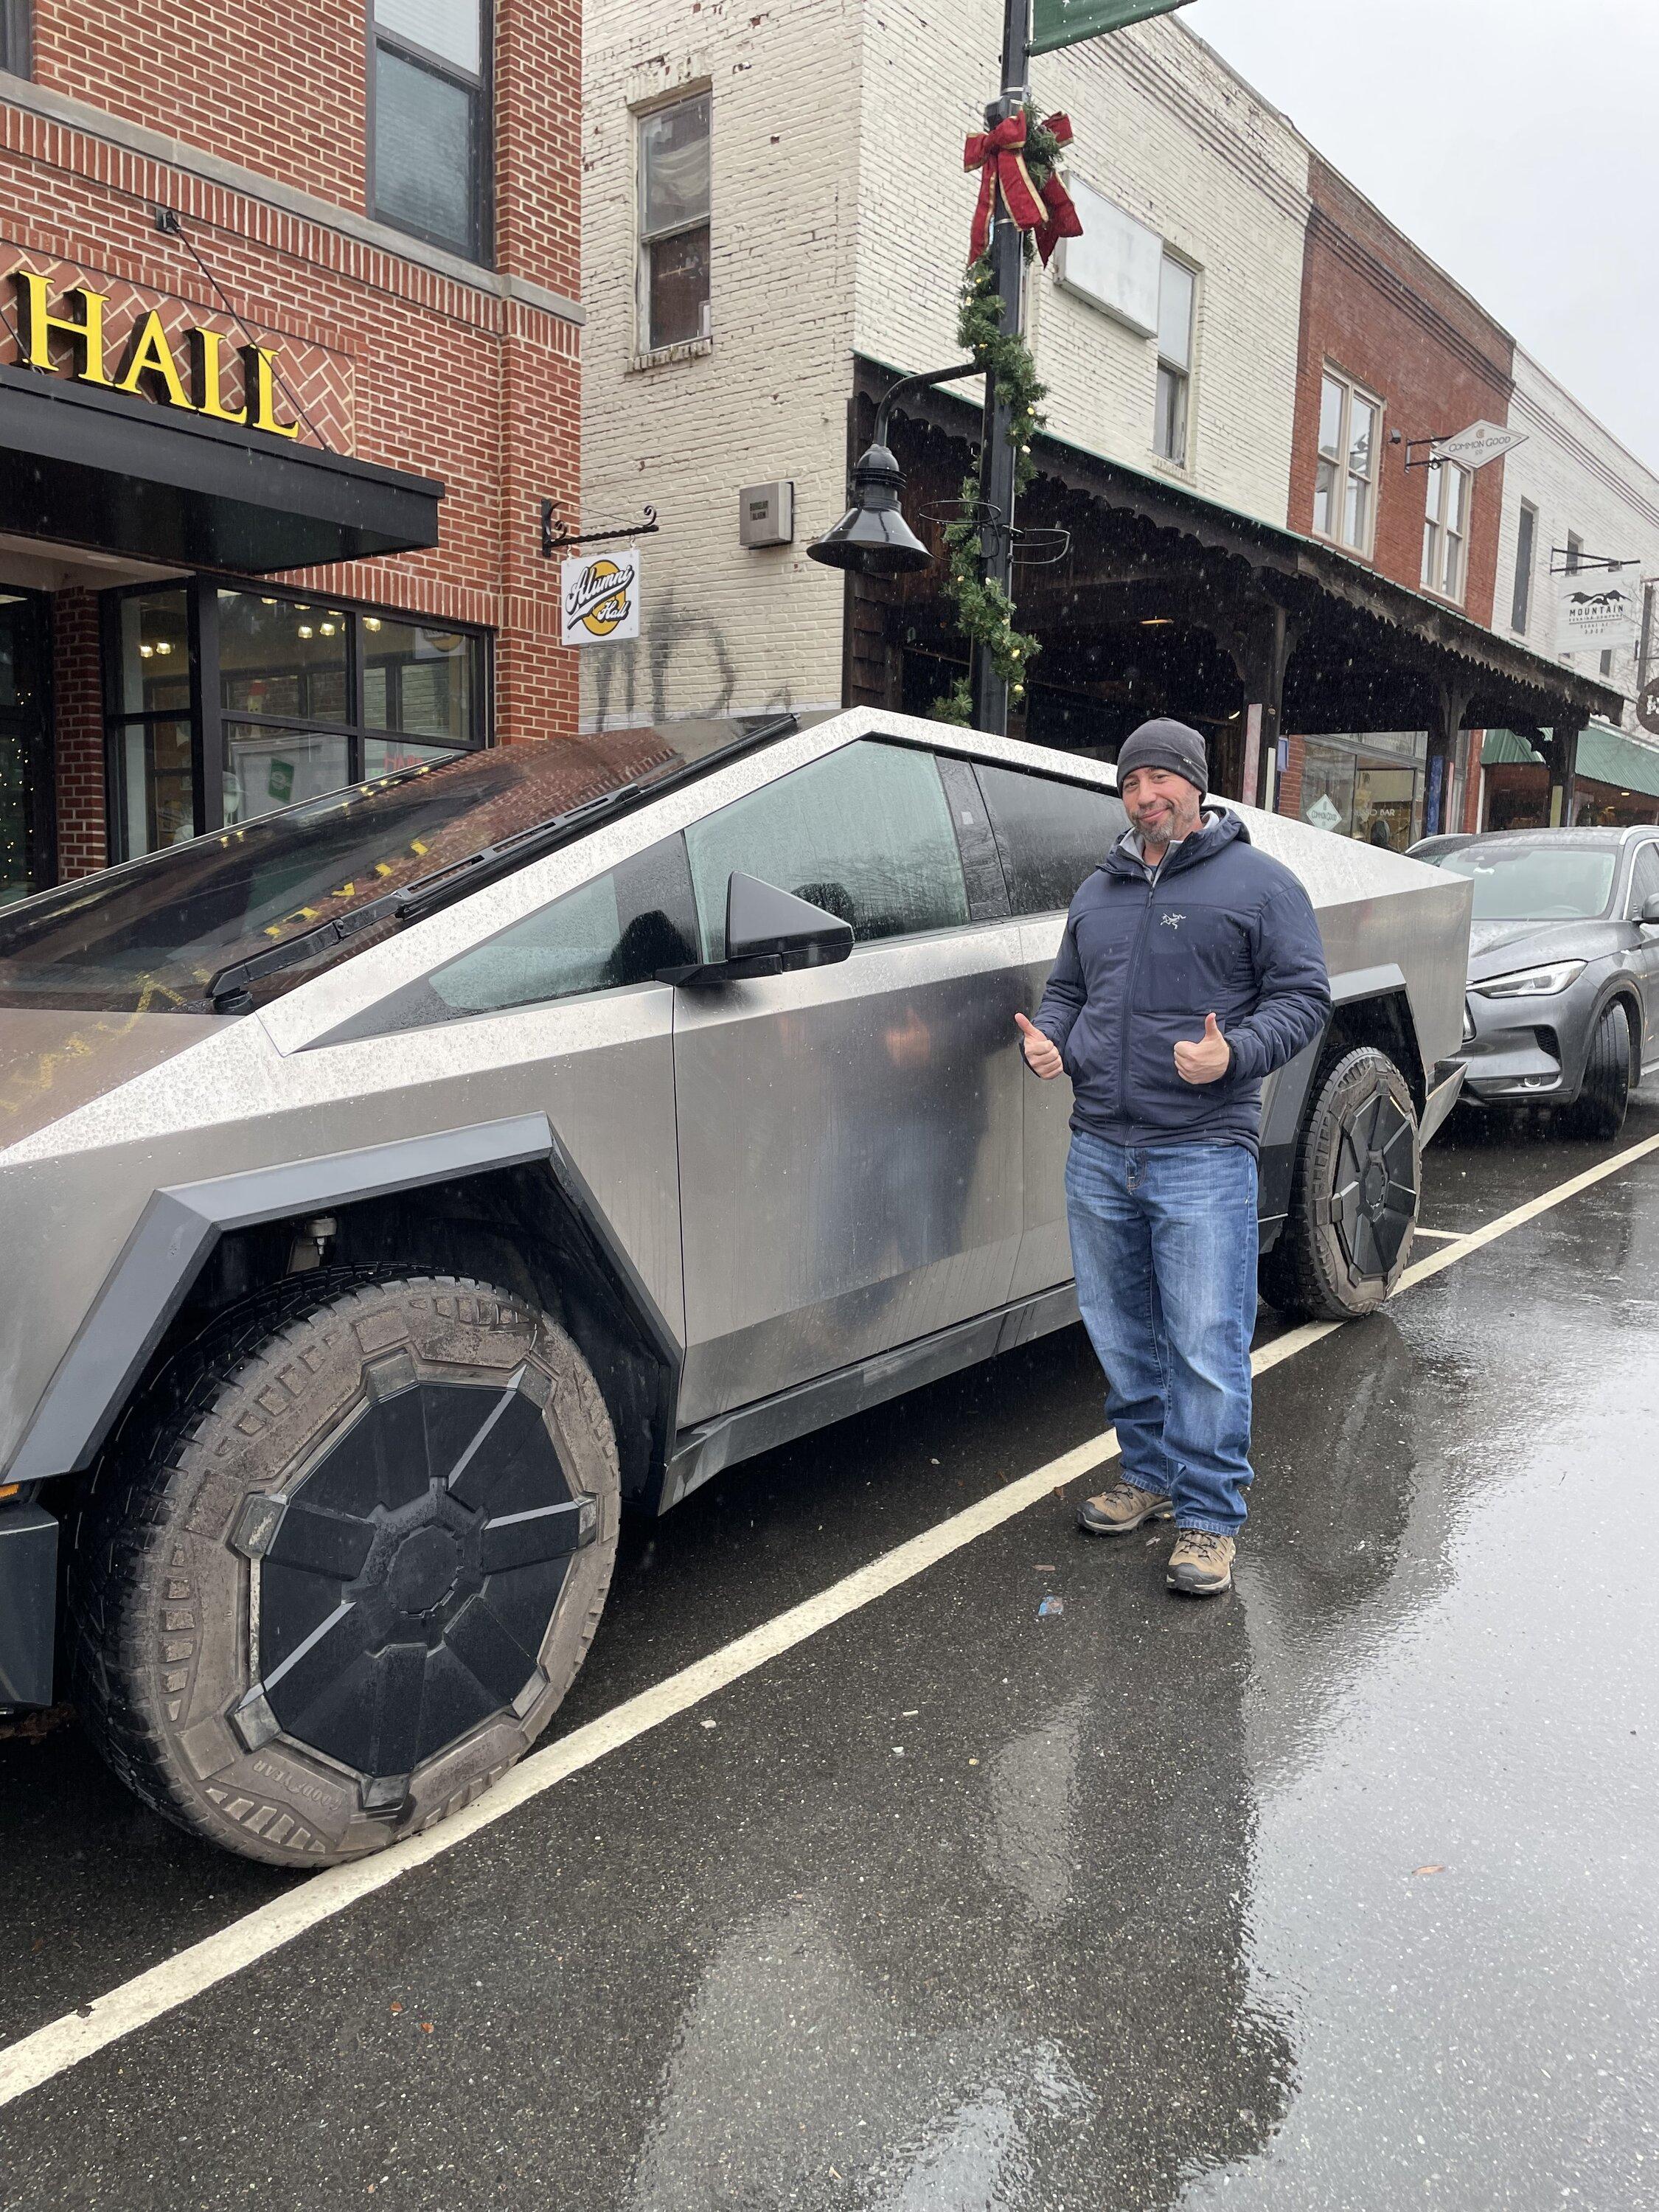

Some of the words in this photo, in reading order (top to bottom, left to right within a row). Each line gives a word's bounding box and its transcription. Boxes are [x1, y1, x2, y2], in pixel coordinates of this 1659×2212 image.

[18, 270, 299, 438] HALL
[1448, 440, 1484, 452] COMMON
[1486, 436, 1512, 447] GOOD
[566, 565, 634, 615] Alumni
[597, 599, 631, 622] Hall
[1569, 605, 1624, 616] MOUNTAIN
